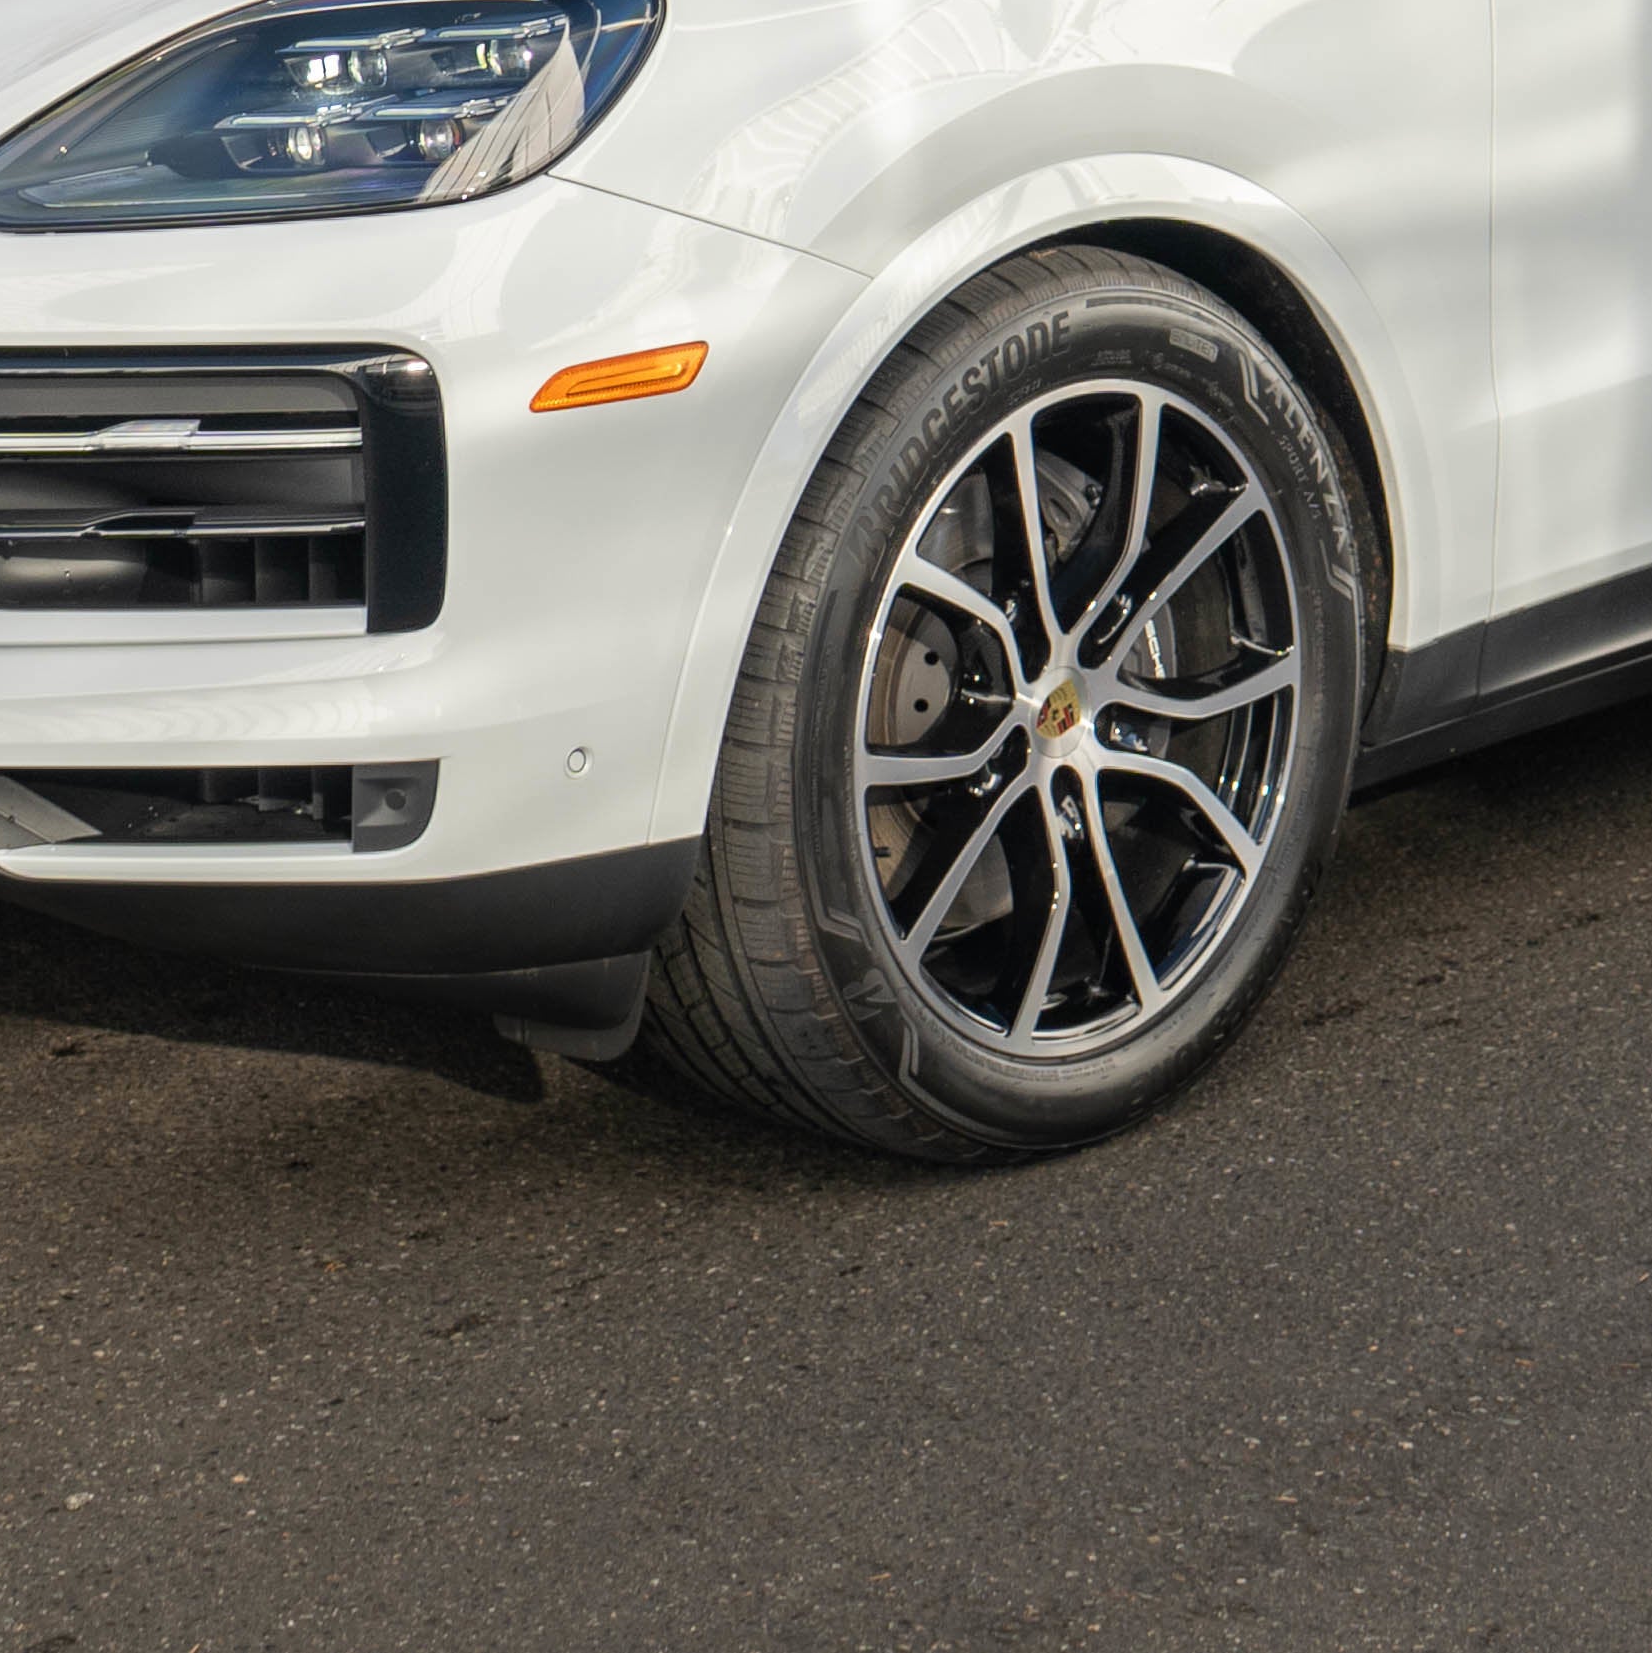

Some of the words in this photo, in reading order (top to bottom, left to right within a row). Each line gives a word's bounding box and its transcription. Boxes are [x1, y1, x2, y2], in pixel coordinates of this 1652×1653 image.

[849, 311, 1071, 564] BRIDGESTONE
[1264, 376, 1350, 554] ALENZA
[1277, 433, 1309, 484] SPORT
